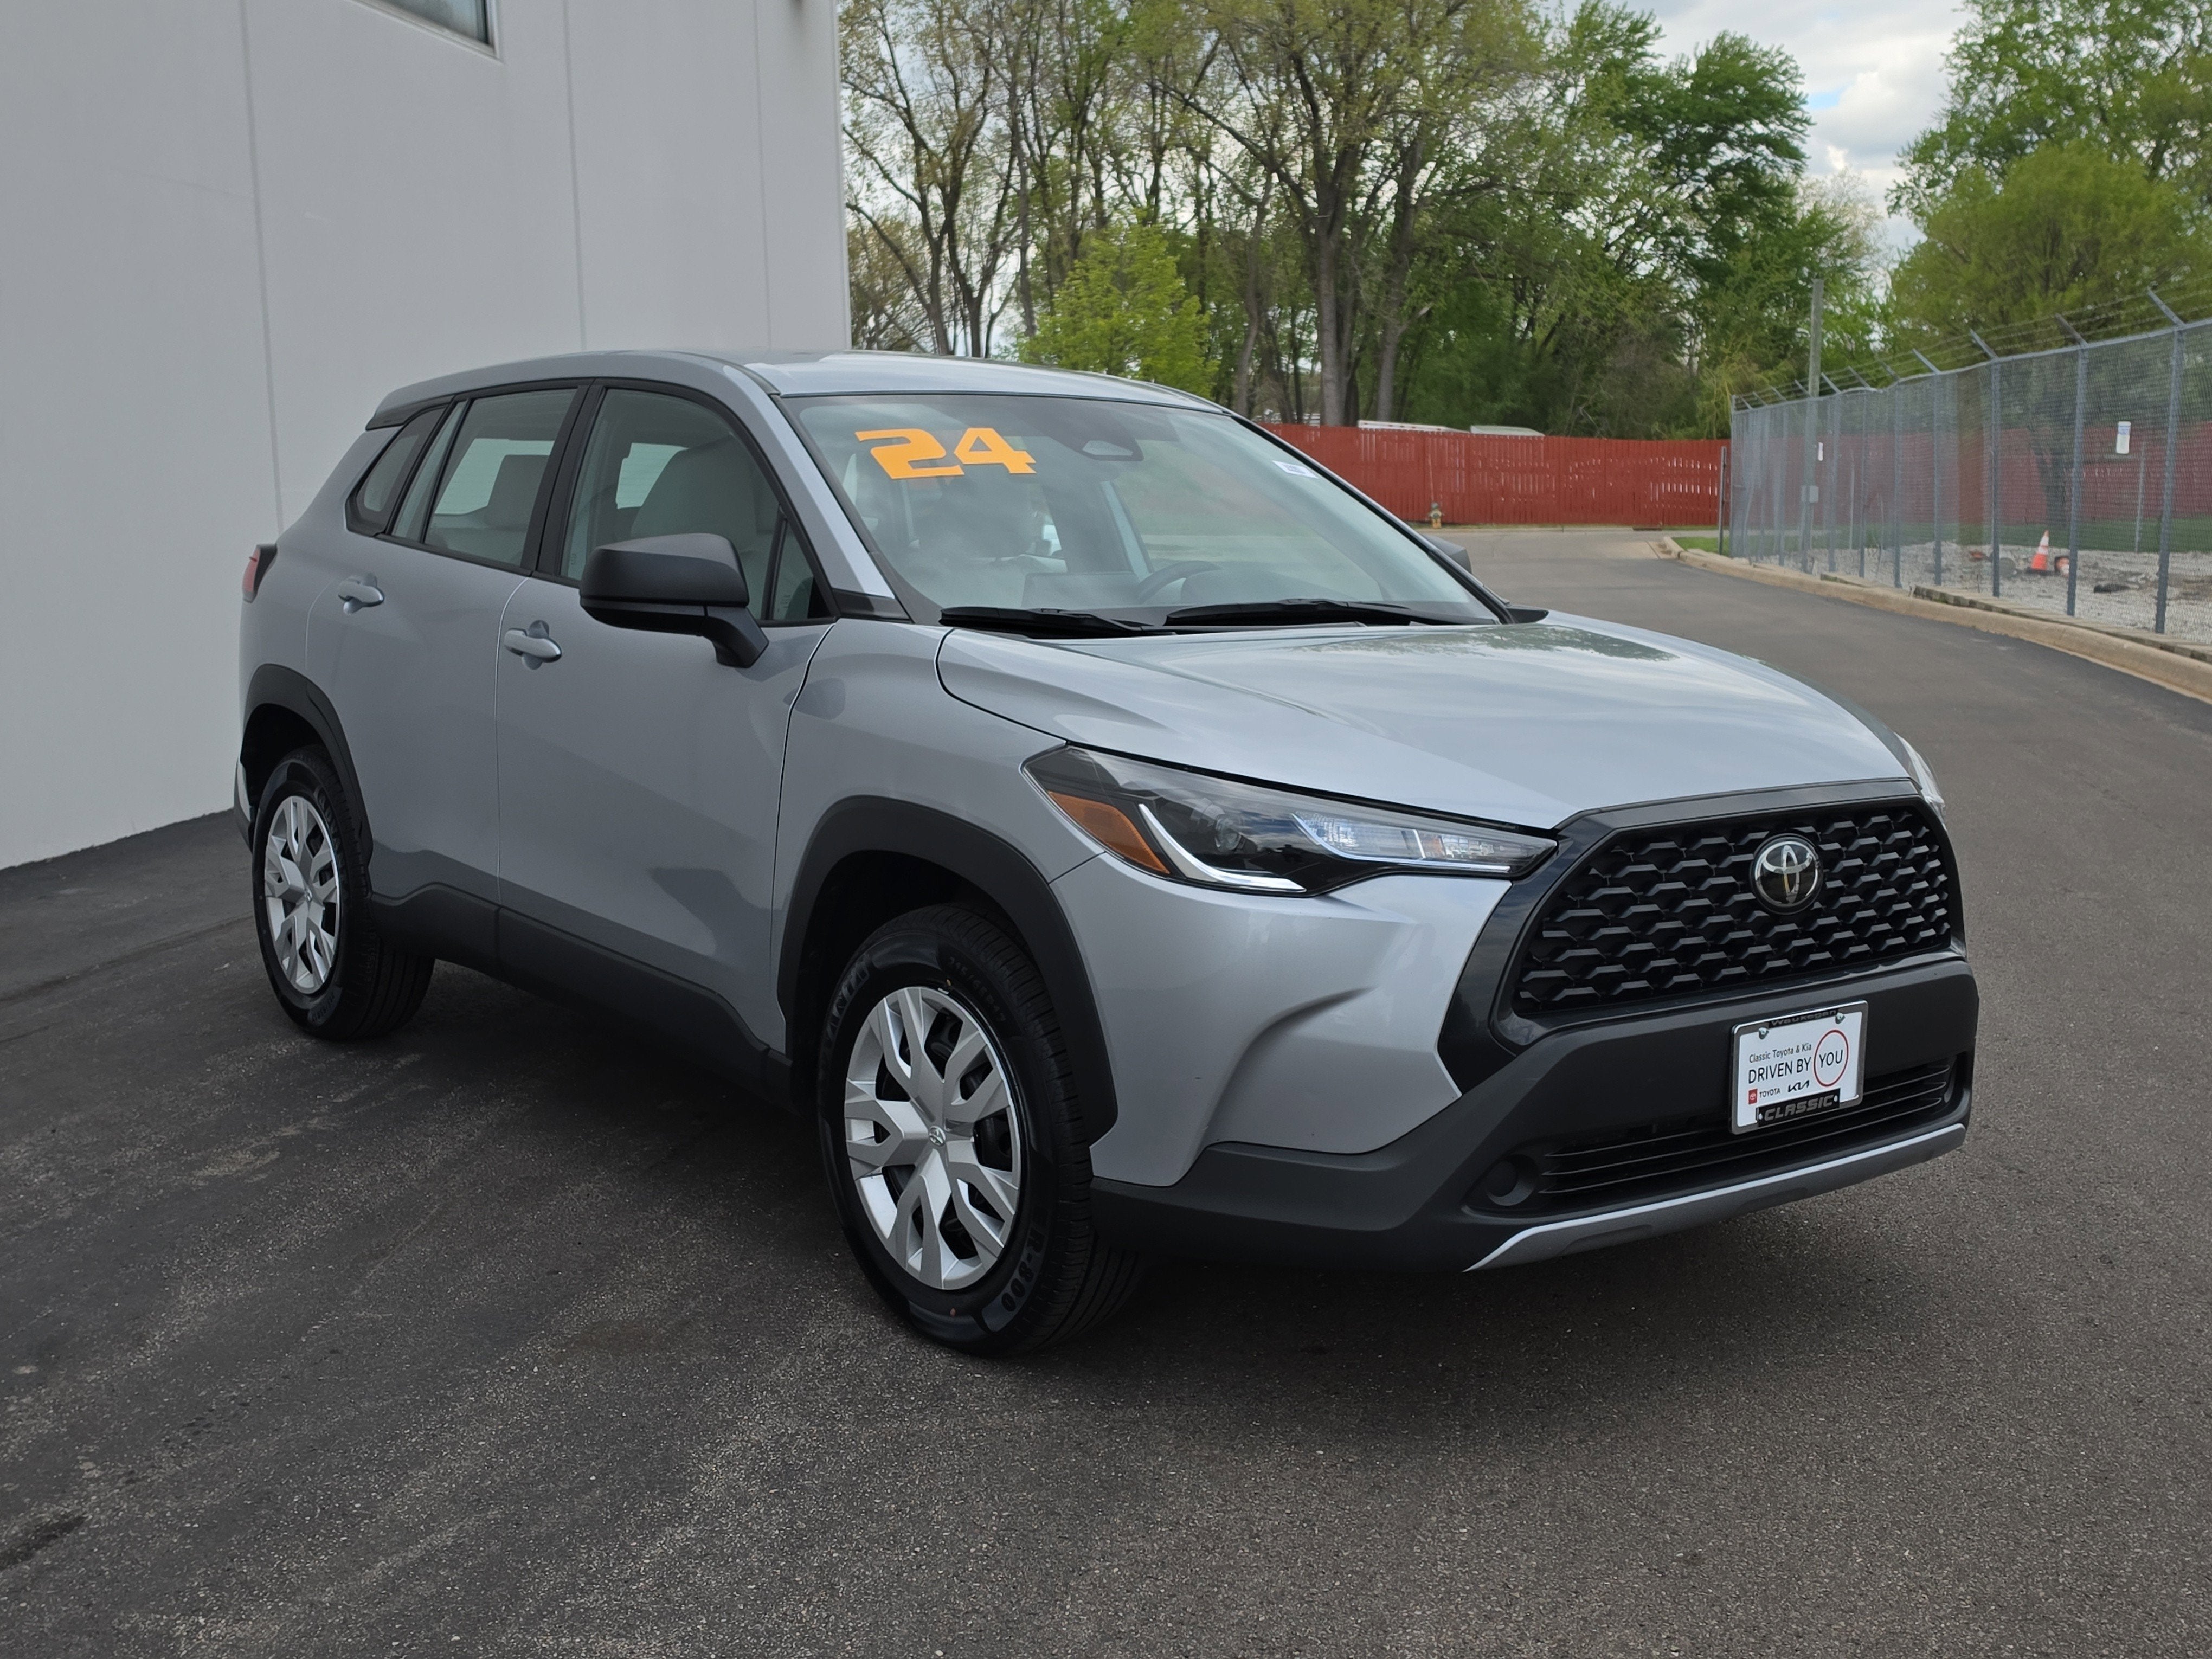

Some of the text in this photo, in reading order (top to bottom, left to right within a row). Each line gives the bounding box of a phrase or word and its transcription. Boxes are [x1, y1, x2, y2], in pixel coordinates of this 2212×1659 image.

[854, 427, 1037, 479] 24
[1771, 1009, 1836, 1026] Waukegan
[1749, 1043, 1812, 1063] Classic Toyota & Kia
[1748, 1049, 1843, 1084] DRIVEN BY YOU
[1759, 1088, 1781, 1098] TOYOTA
[1764, 1094, 1834, 1121] CLASSIC
